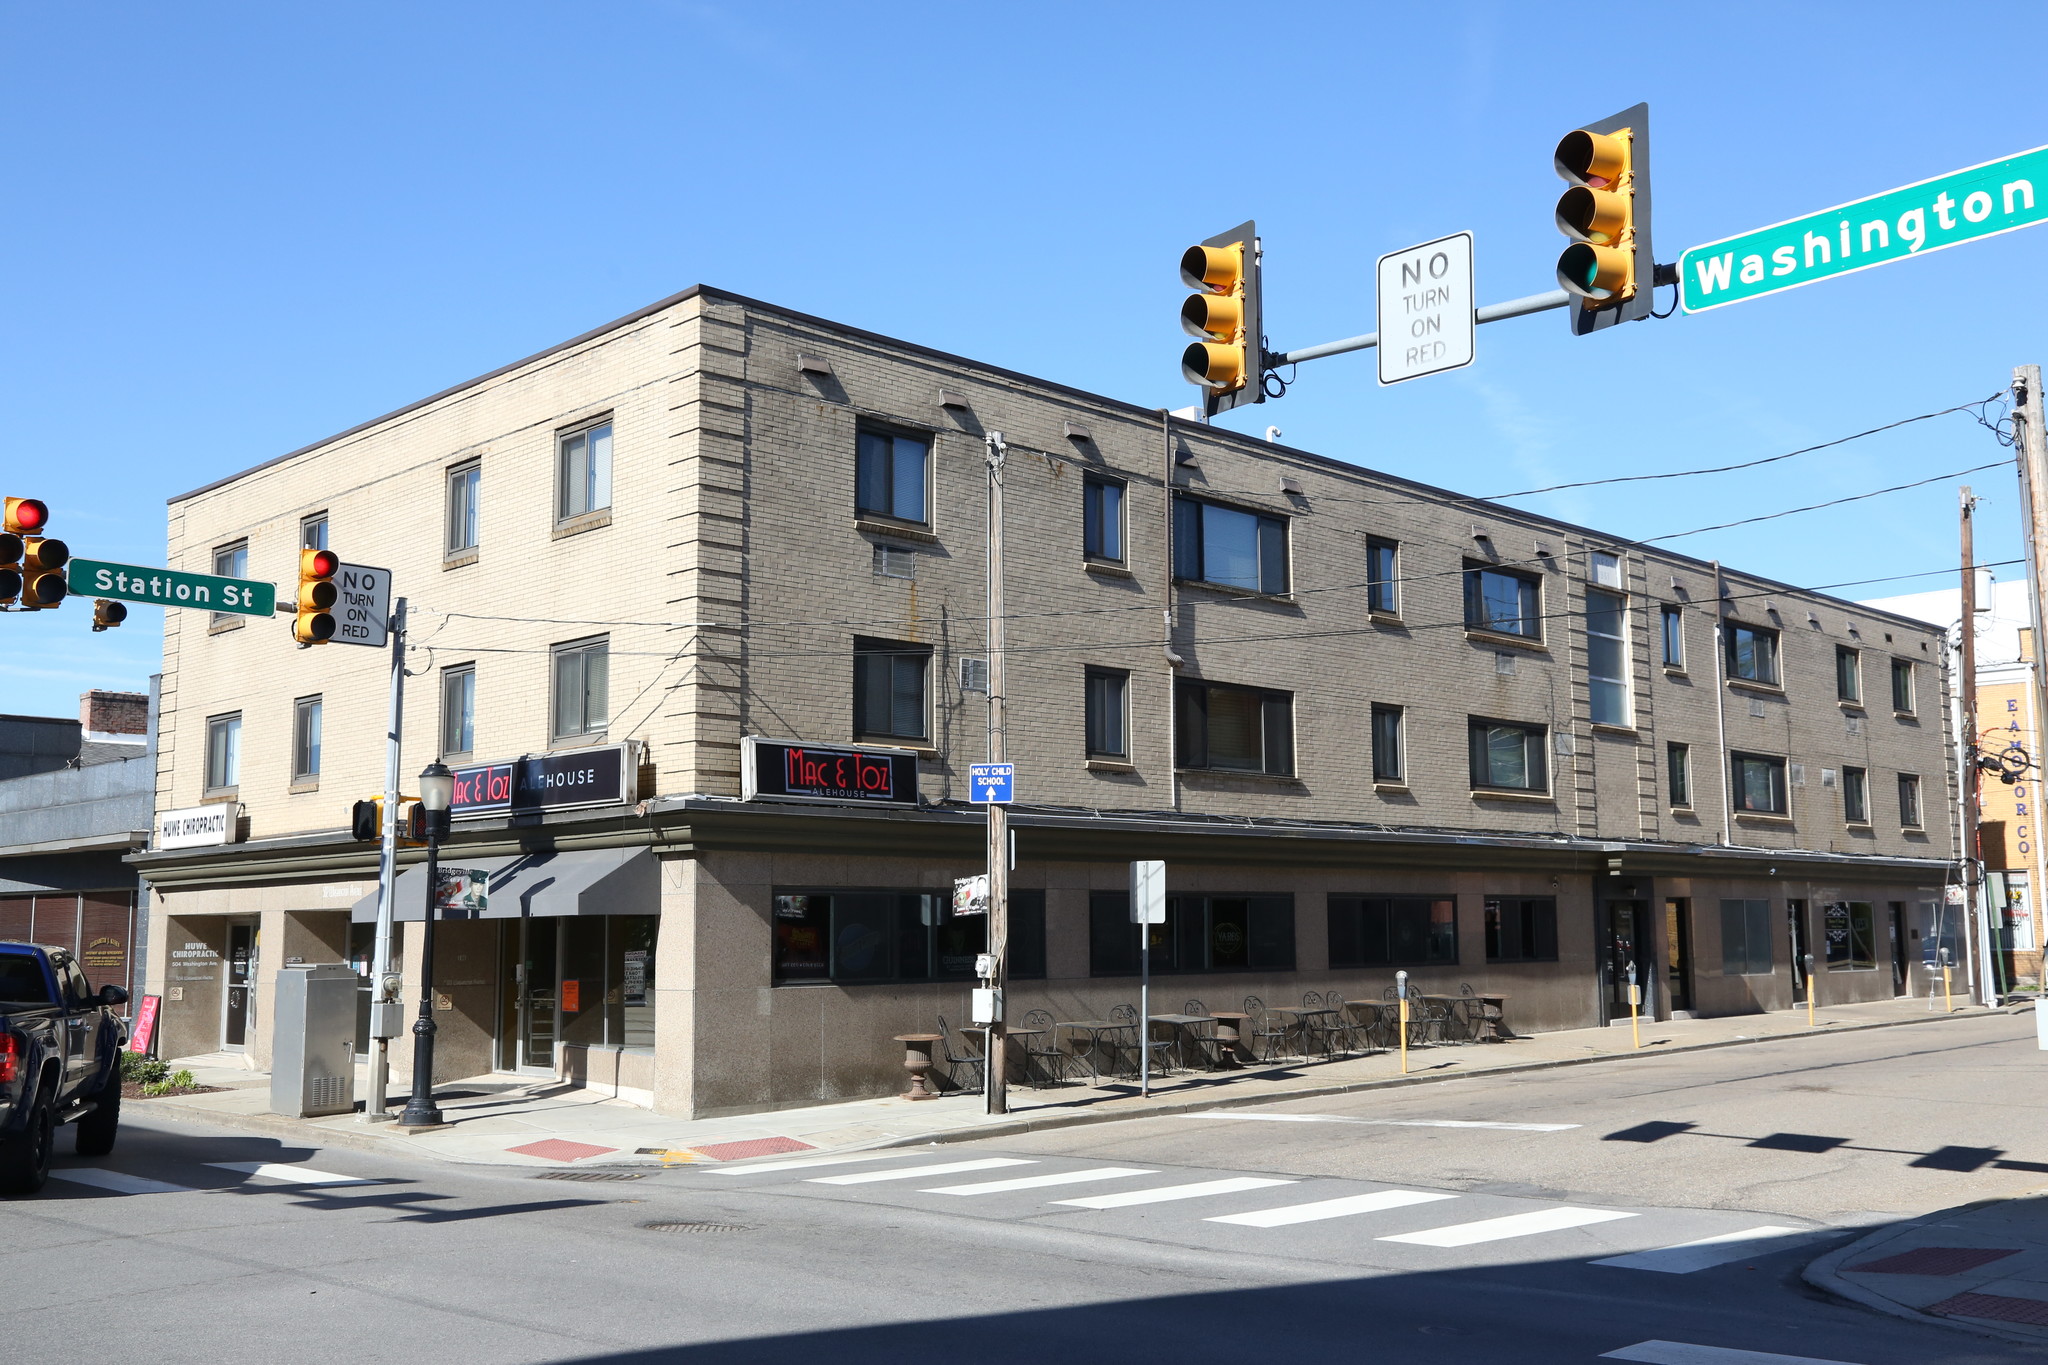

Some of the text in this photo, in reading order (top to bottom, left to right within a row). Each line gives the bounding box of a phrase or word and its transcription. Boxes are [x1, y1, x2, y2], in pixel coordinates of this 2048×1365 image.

[1695, 178, 2035, 295] Washington
[1402, 252, 1449, 288] NO
[1402, 285, 1450, 315] TURN
[1411, 313, 1441, 338] ON
[1406, 340, 1446, 368] RED
[95, 569, 253, 608] Station St
[343, 571, 375, 591] NO
[343, 592, 375, 607] TURN
[347, 608, 368, 622] ON
[342, 623, 370, 639] RED
[519, 768, 595, 790] ALEHOUSE
[836, 758, 846, 788] &
[972, 767, 1012, 776] HOLY CHILD
[977, 777, 1006, 786] SCHOOL
[474, 773, 482, 802] &
[812, 788, 865, 798] ALEHOUSE
[163, 814, 225, 838] HUWE CHIROPRACTIC
[437, 867, 473, 876] Bridgeville
[172, 950, 219, 958] CHIROPRACTIC
[185, 942, 207, 950] HUWE
